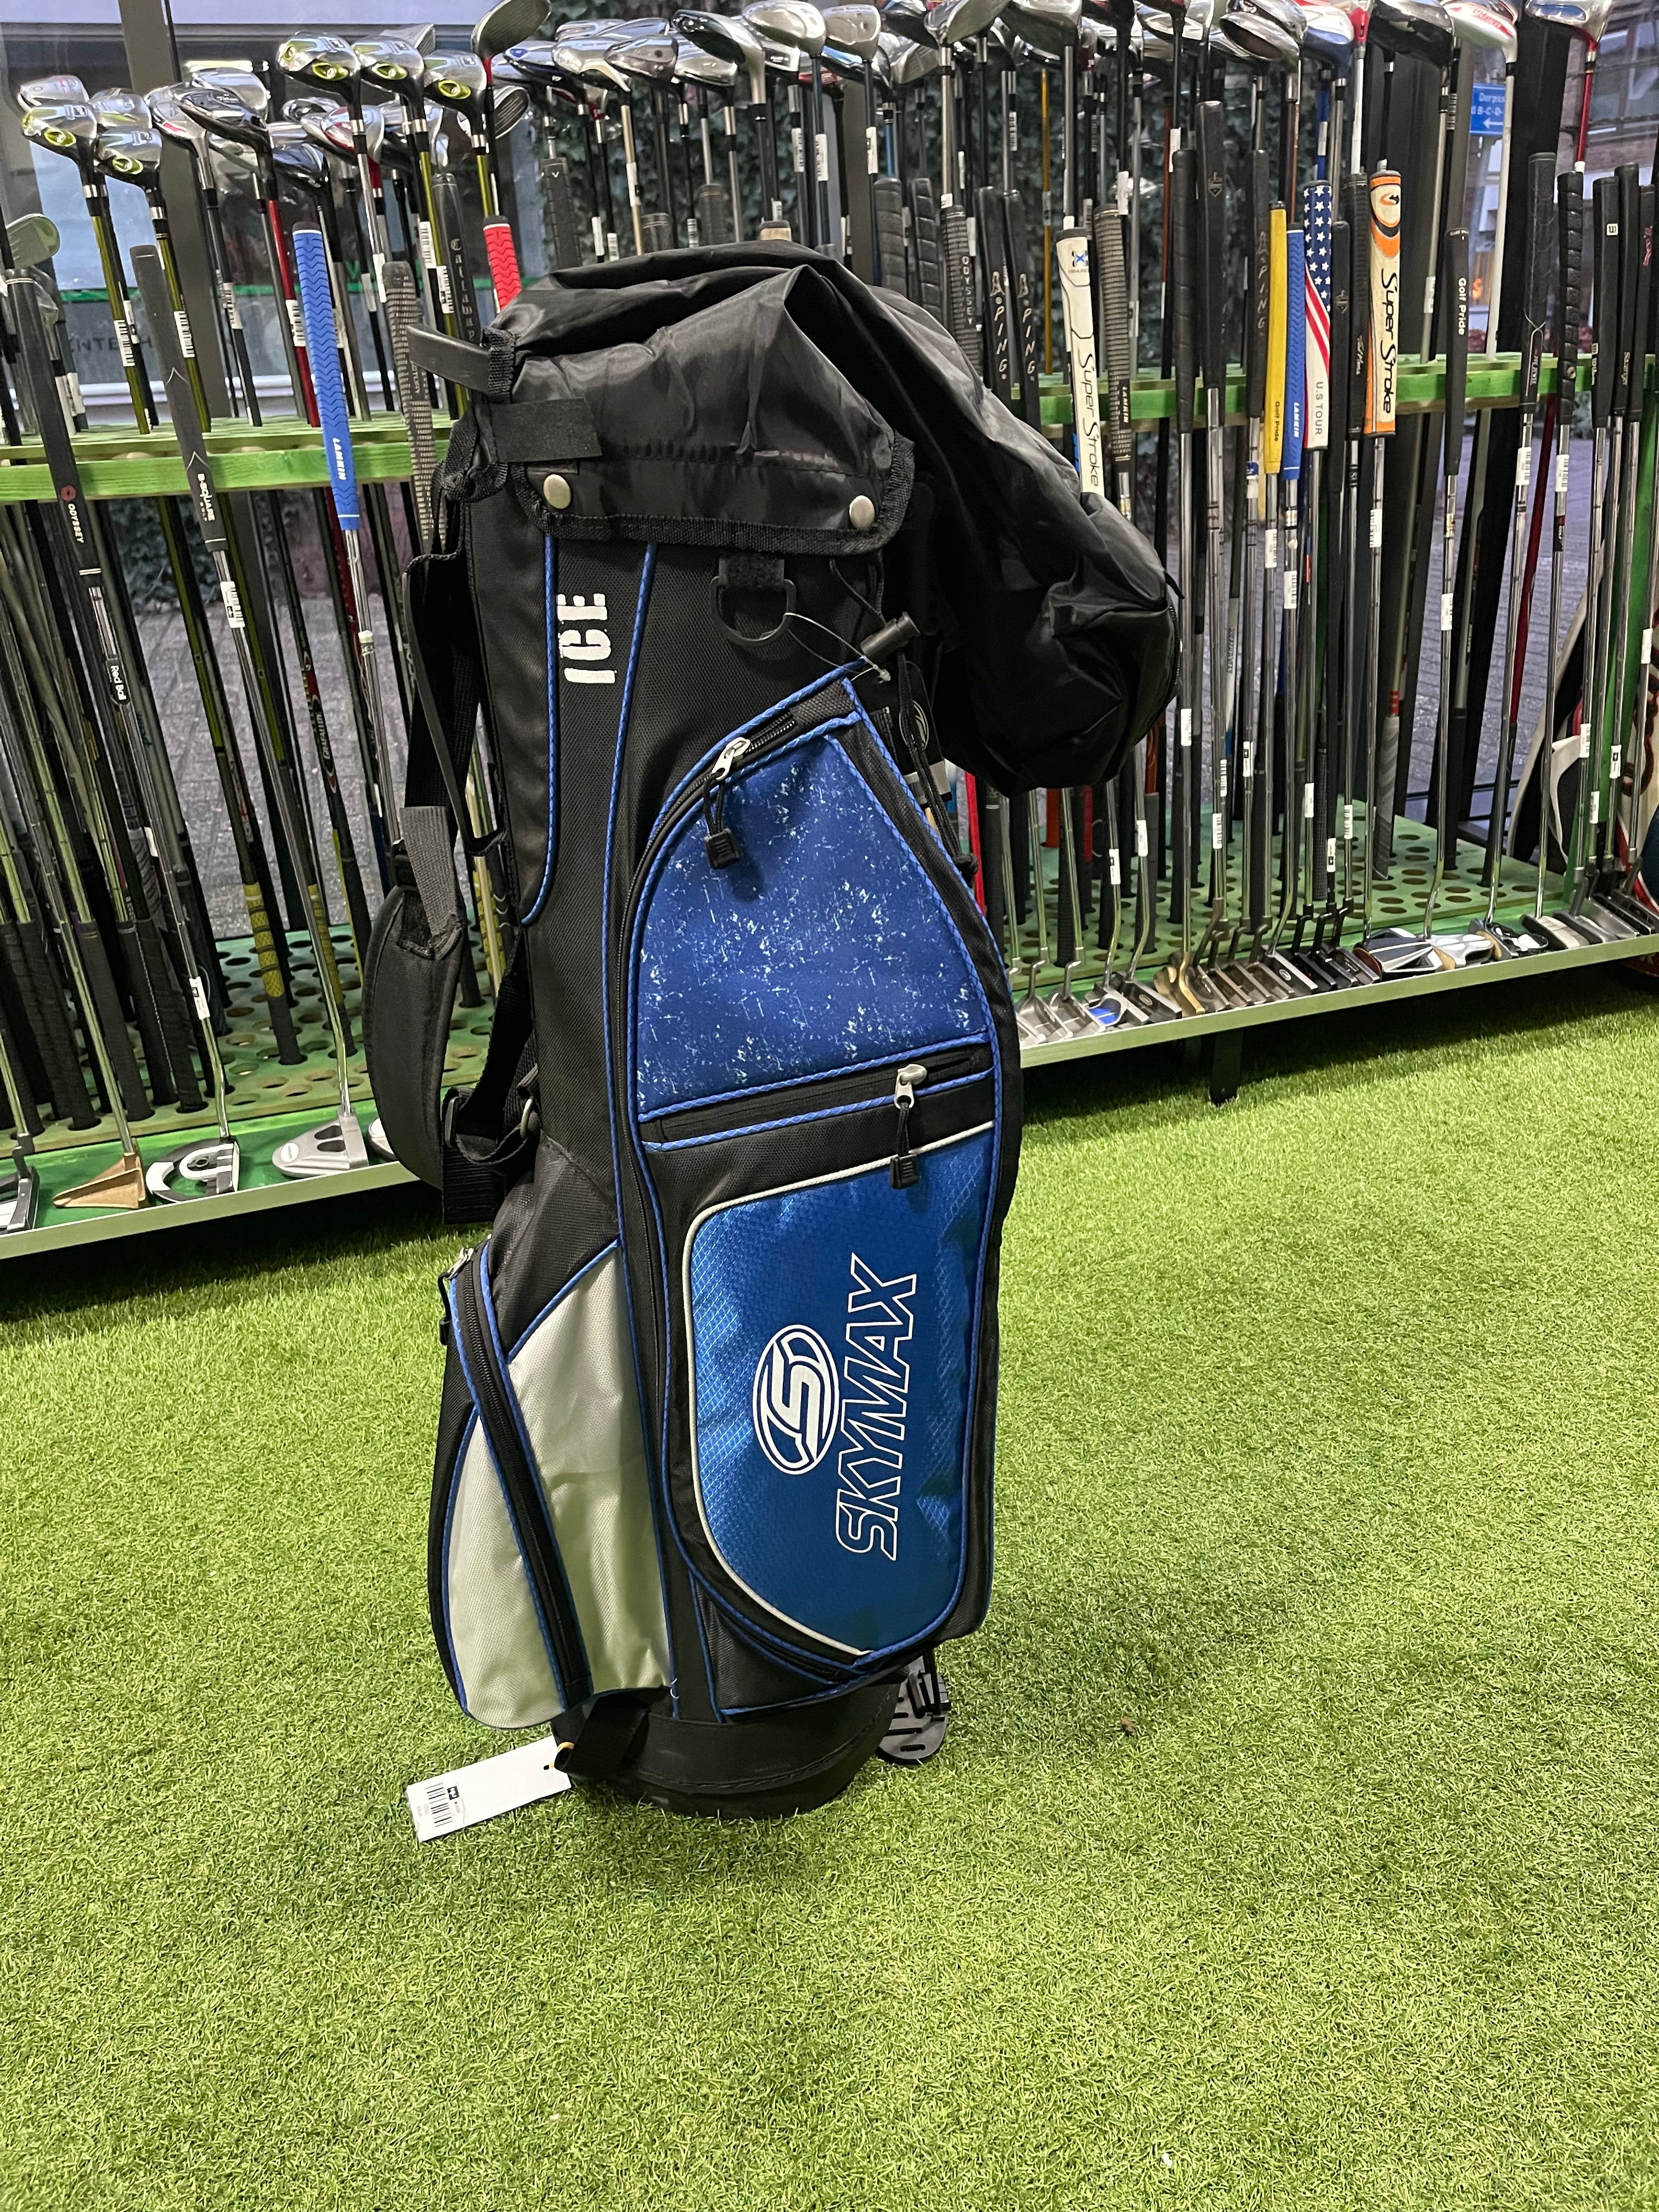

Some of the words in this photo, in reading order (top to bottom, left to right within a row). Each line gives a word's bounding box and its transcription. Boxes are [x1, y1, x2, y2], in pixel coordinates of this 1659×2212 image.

[961, 256, 974, 325] ODYSSEY
[1458, 277, 1467, 301] Golf
[994, 306, 1008, 373] PING
[1022, 308, 1036, 375] PING
[1458, 304, 1467, 336] Pride
[1314, 403, 1323, 435] TOUR
[332, 437, 347, 481] LAMKIN
[67, 504, 85, 544] ODYSSEY
[556, 592, 617, 684] ICE
[110, 665, 123, 685] Red
[834, 1251, 917, 1562] SKYMAX
